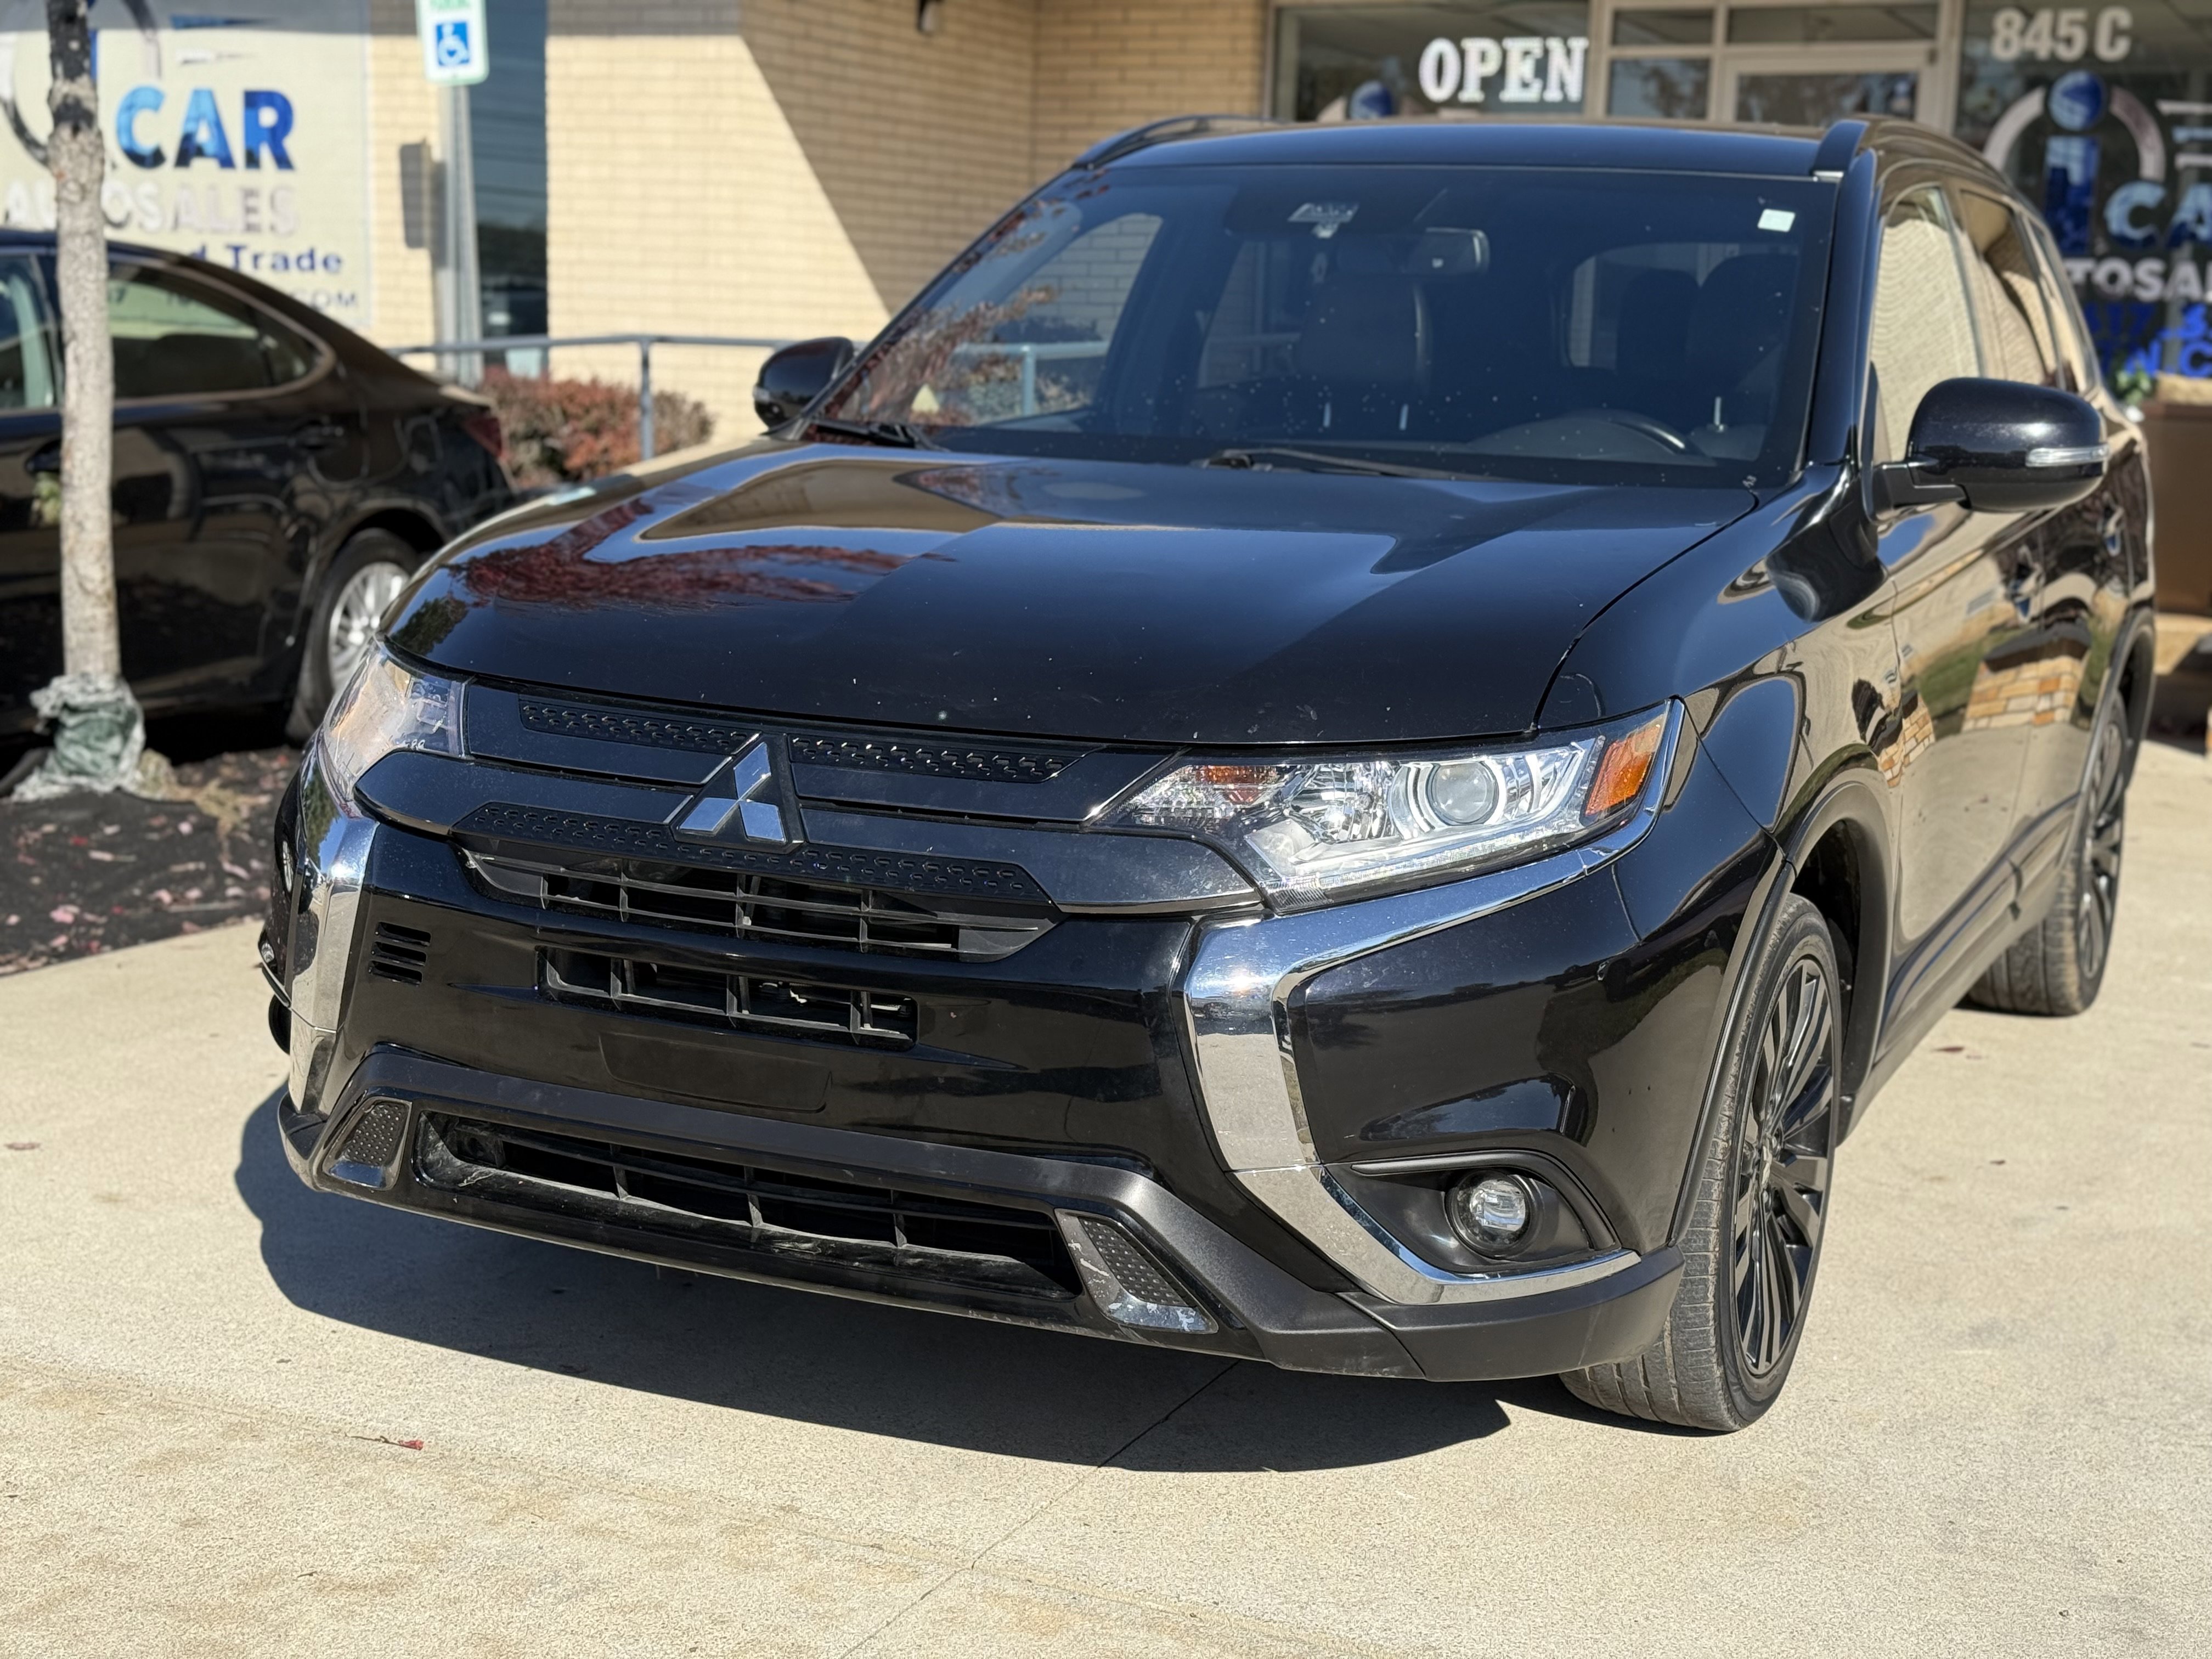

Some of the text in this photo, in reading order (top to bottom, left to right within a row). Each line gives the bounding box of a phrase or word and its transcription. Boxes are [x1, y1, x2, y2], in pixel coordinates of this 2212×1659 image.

[1991, 6, 2133, 61] 845 C
[1418, 37, 1589, 103] OPEN
[116, 86, 296, 171] CAR
[3, 180, 299, 234] AUOSALES
[225, 244, 342, 273] Trade
